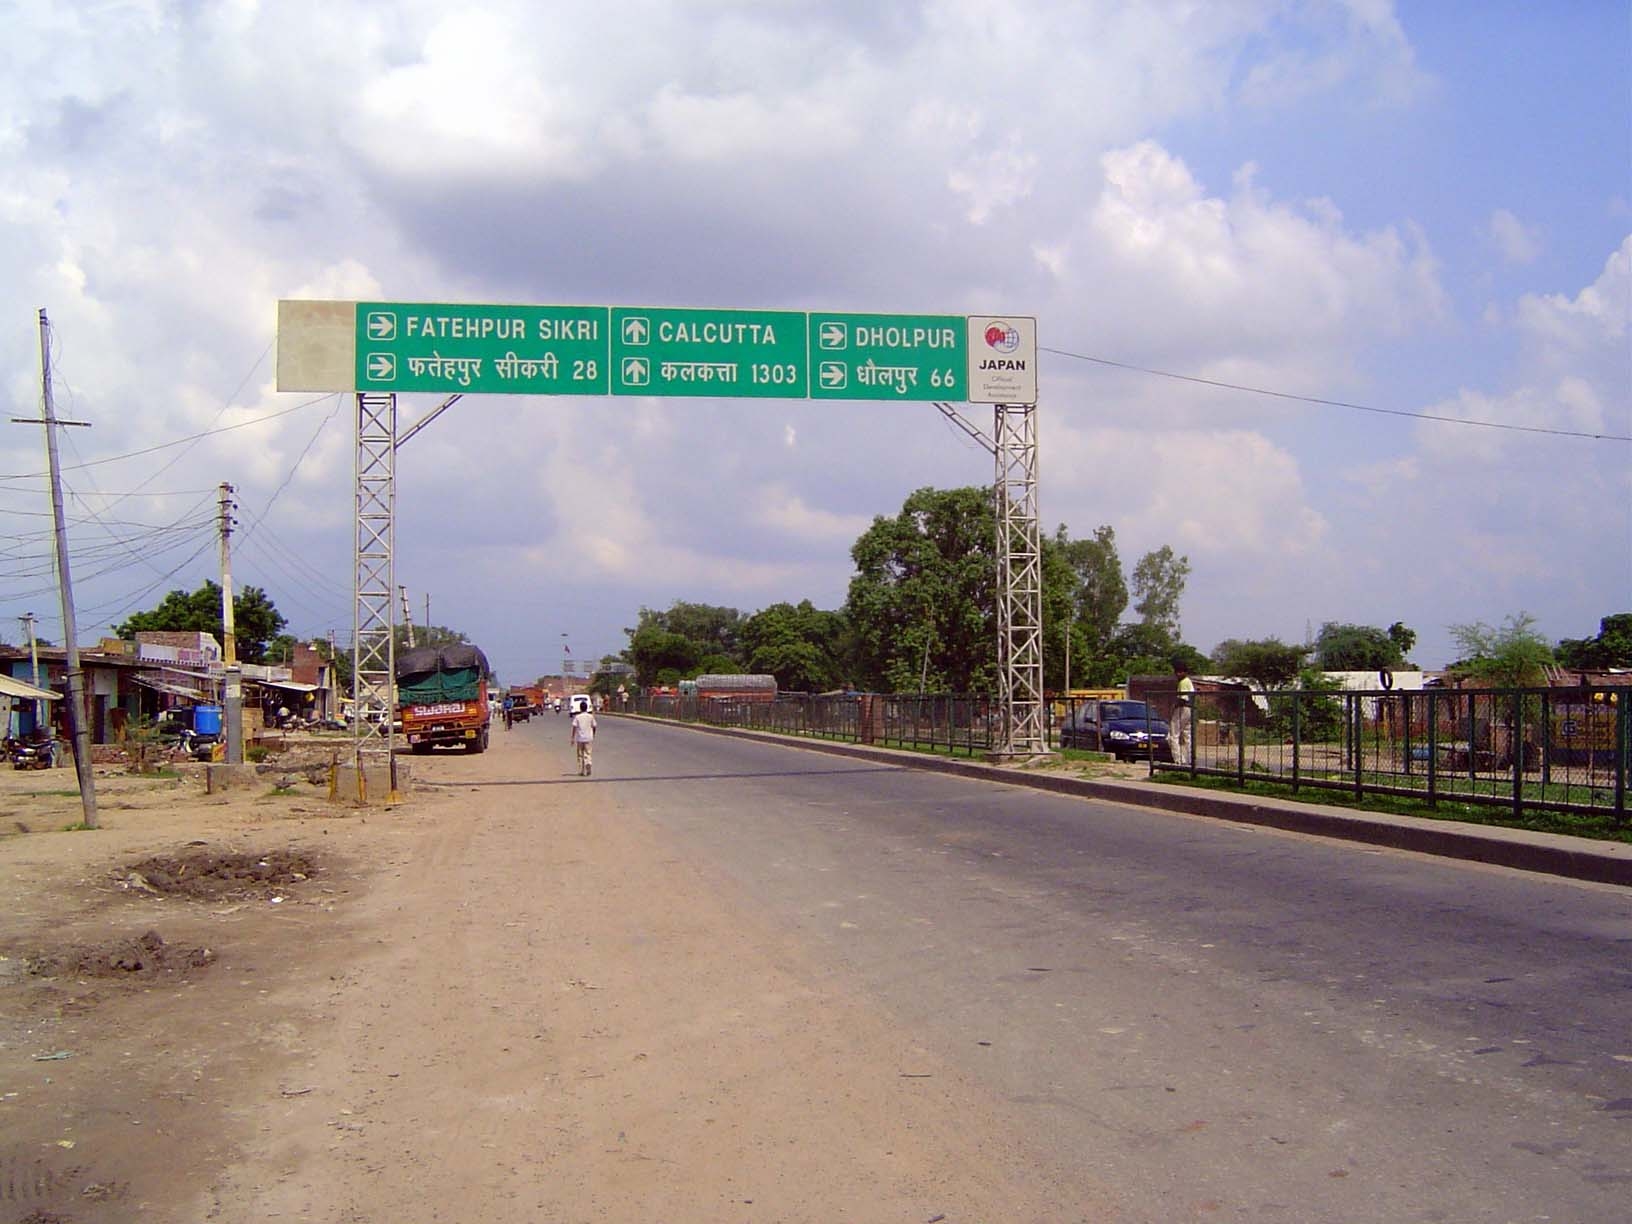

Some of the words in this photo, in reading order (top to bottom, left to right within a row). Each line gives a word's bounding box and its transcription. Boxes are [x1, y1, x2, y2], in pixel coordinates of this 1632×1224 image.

[407, 317, 525, 339] FATEHPUR
[539, 319, 598, 340] SIKRI
[659, 322, 776, 344] CALCUTTA
[856, 327, 955, 349] DHOLPUR
[407, 350, 482, 386] फतेहपुर
[494, 351, 559, 379] सीकरी
[573, 360, 598, 380] 28
[661, 362, 738, 382] कलकत्ता
[752, 364, 797, 384] 1303
[979, 359, 1025, 370] JAPAN
[857, 358, 918, 394] धौलपुर
[930, 369, 955, 388] 66
